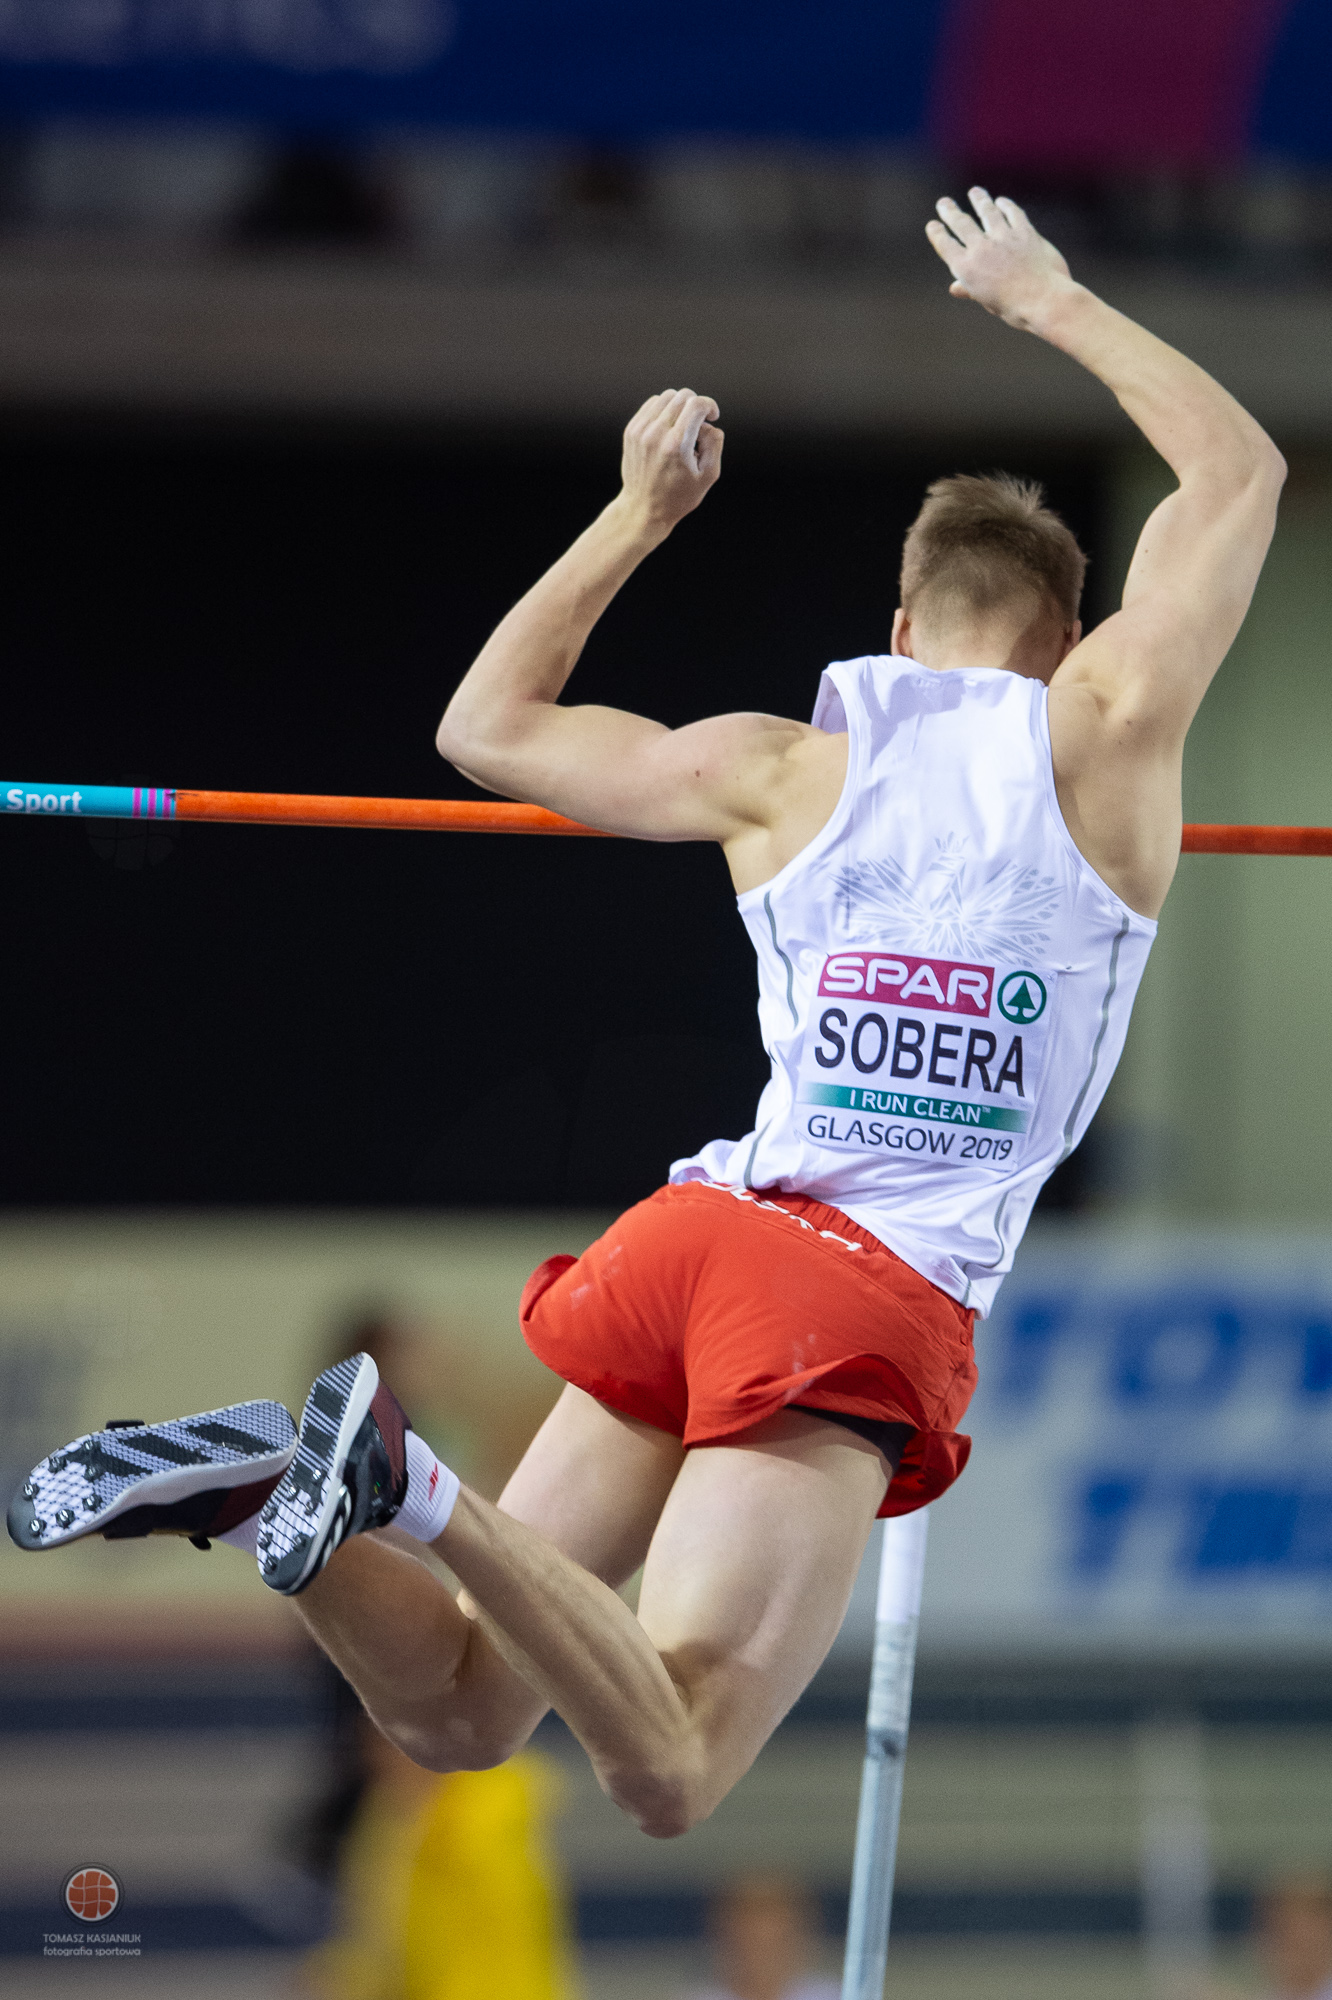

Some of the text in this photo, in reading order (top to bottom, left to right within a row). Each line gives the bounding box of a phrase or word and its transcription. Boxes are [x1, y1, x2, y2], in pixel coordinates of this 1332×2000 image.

[6, 788, 83, 813] Sport
[823, 956, 990, 1010] SPAR
[814, 1008, 1026, 1098] SOBERA
[850, 1089, 856, 1107] I
[861, 1090, 908, 1113] RUN
[807, 1114, 1013, 1161] GLASGOW 2019
